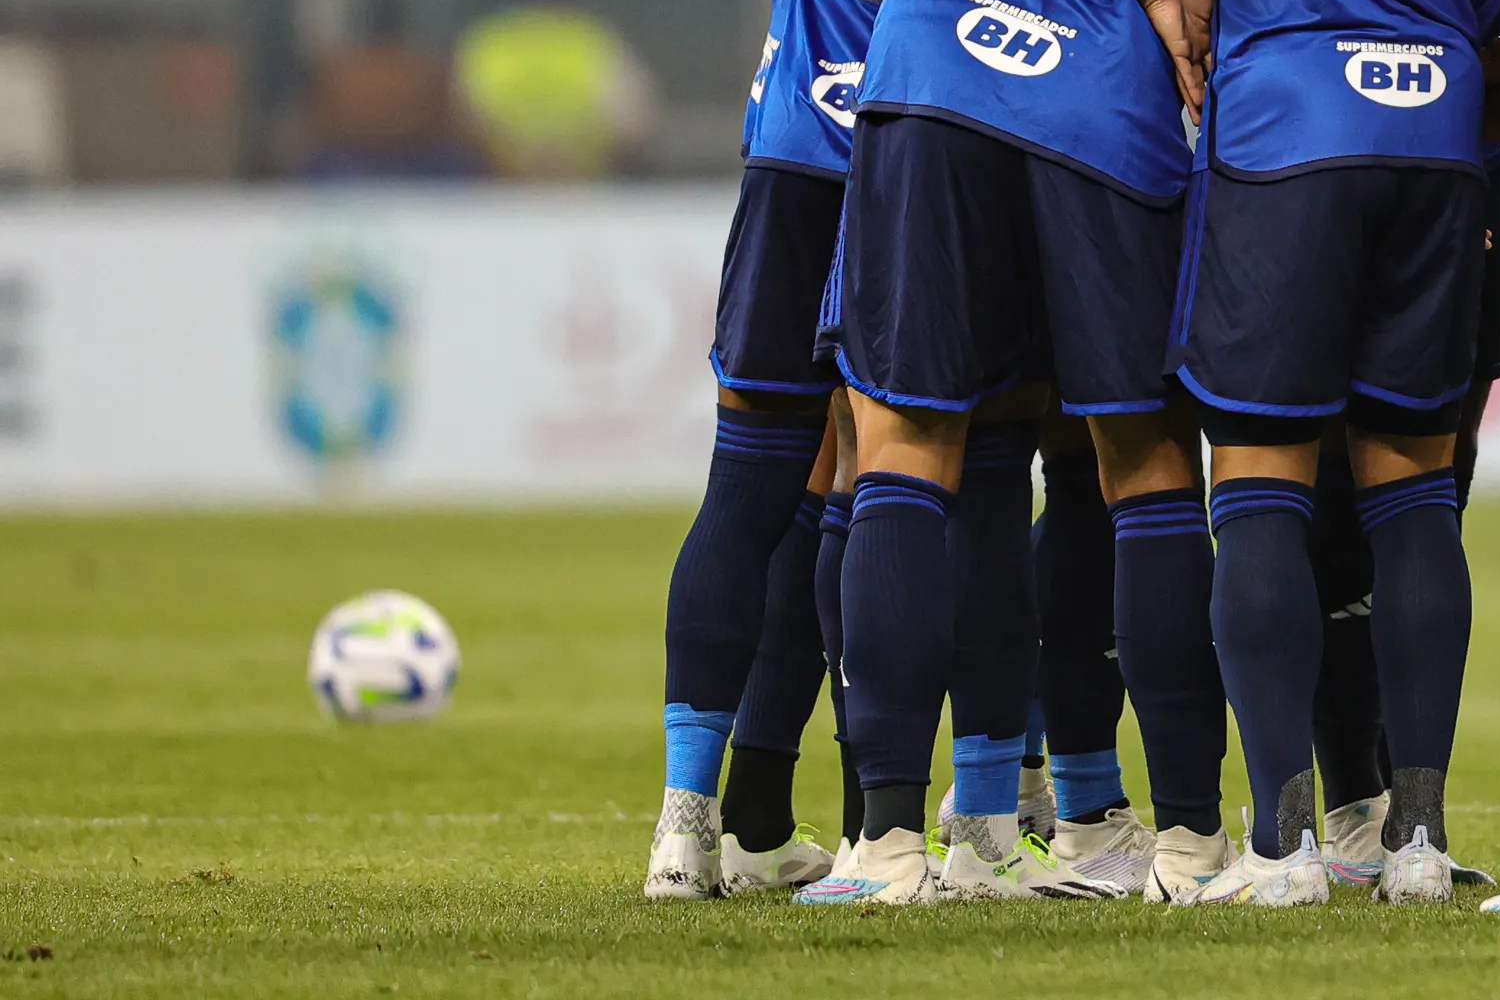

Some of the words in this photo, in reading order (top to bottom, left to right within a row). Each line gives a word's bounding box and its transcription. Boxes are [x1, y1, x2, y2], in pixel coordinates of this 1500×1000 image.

[964, 15, 1054, 67] BH
[1336, 41, 1444, 57] SUPERMERCADOS
[1360, 60, 1432, 93] BH
